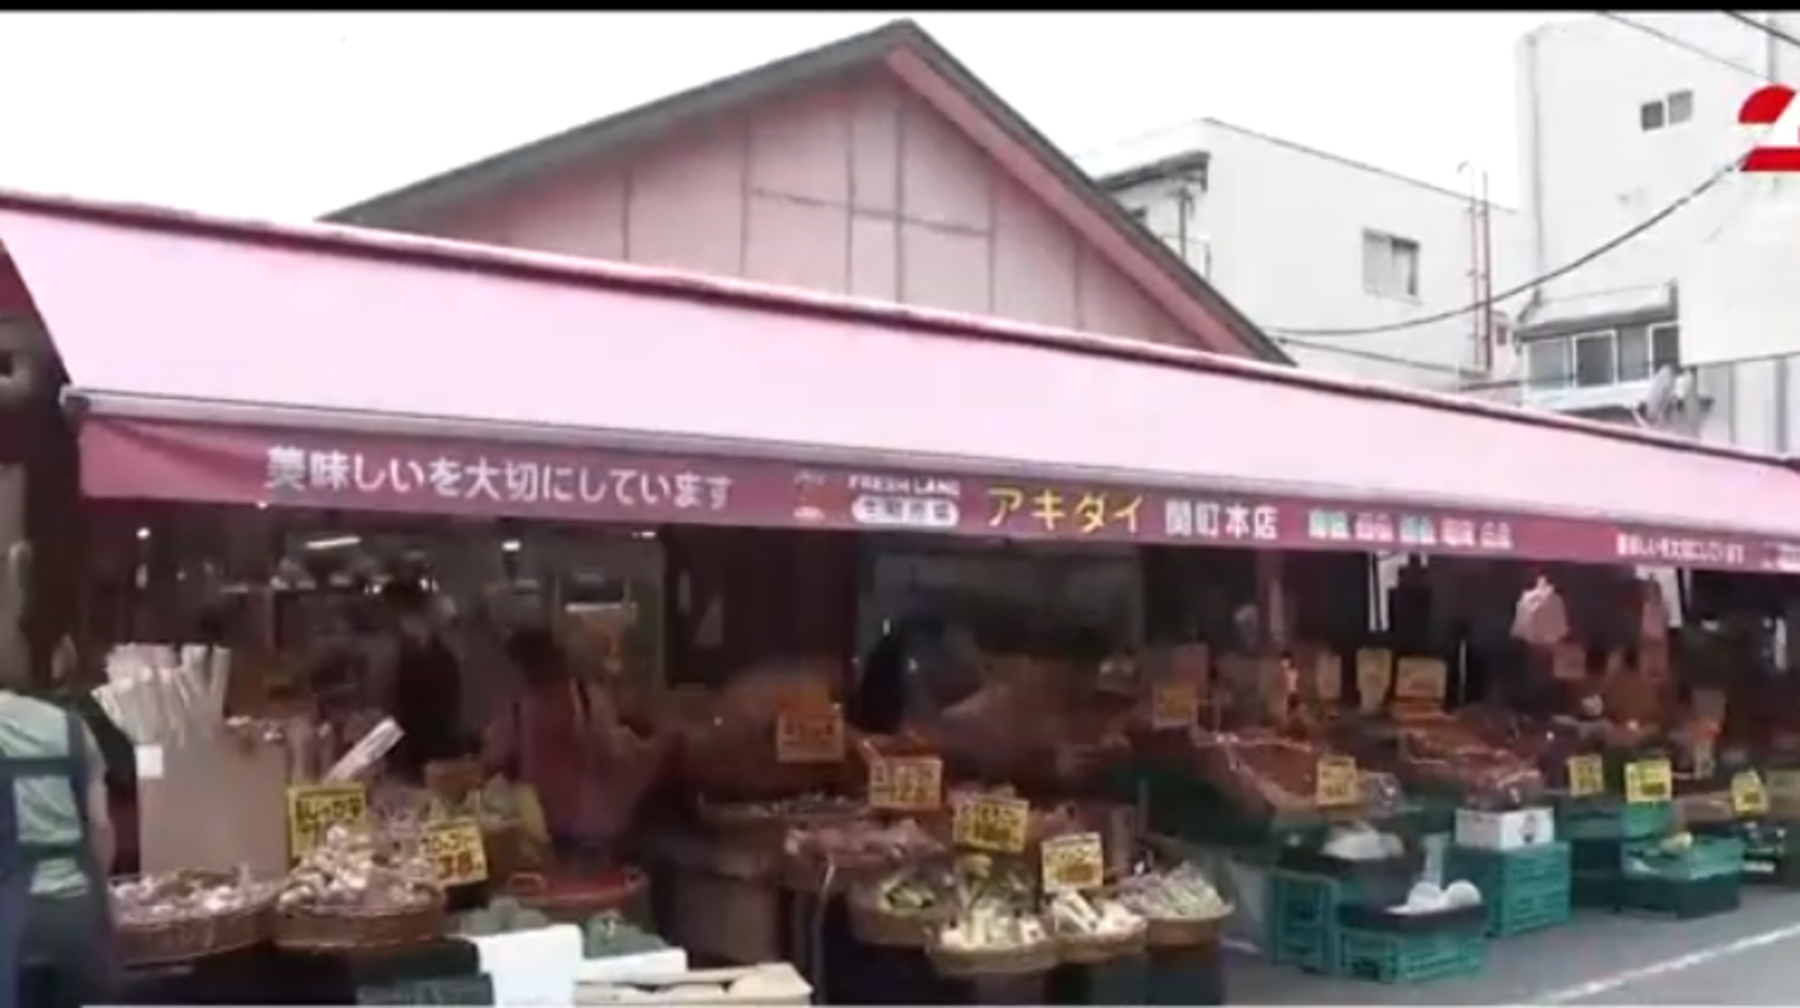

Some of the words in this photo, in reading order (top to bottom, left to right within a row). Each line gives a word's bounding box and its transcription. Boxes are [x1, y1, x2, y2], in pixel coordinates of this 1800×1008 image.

[265, 446, 731, 510] 美味しいを大切にしています
[987, 488, 1143, 534] アキダイ
